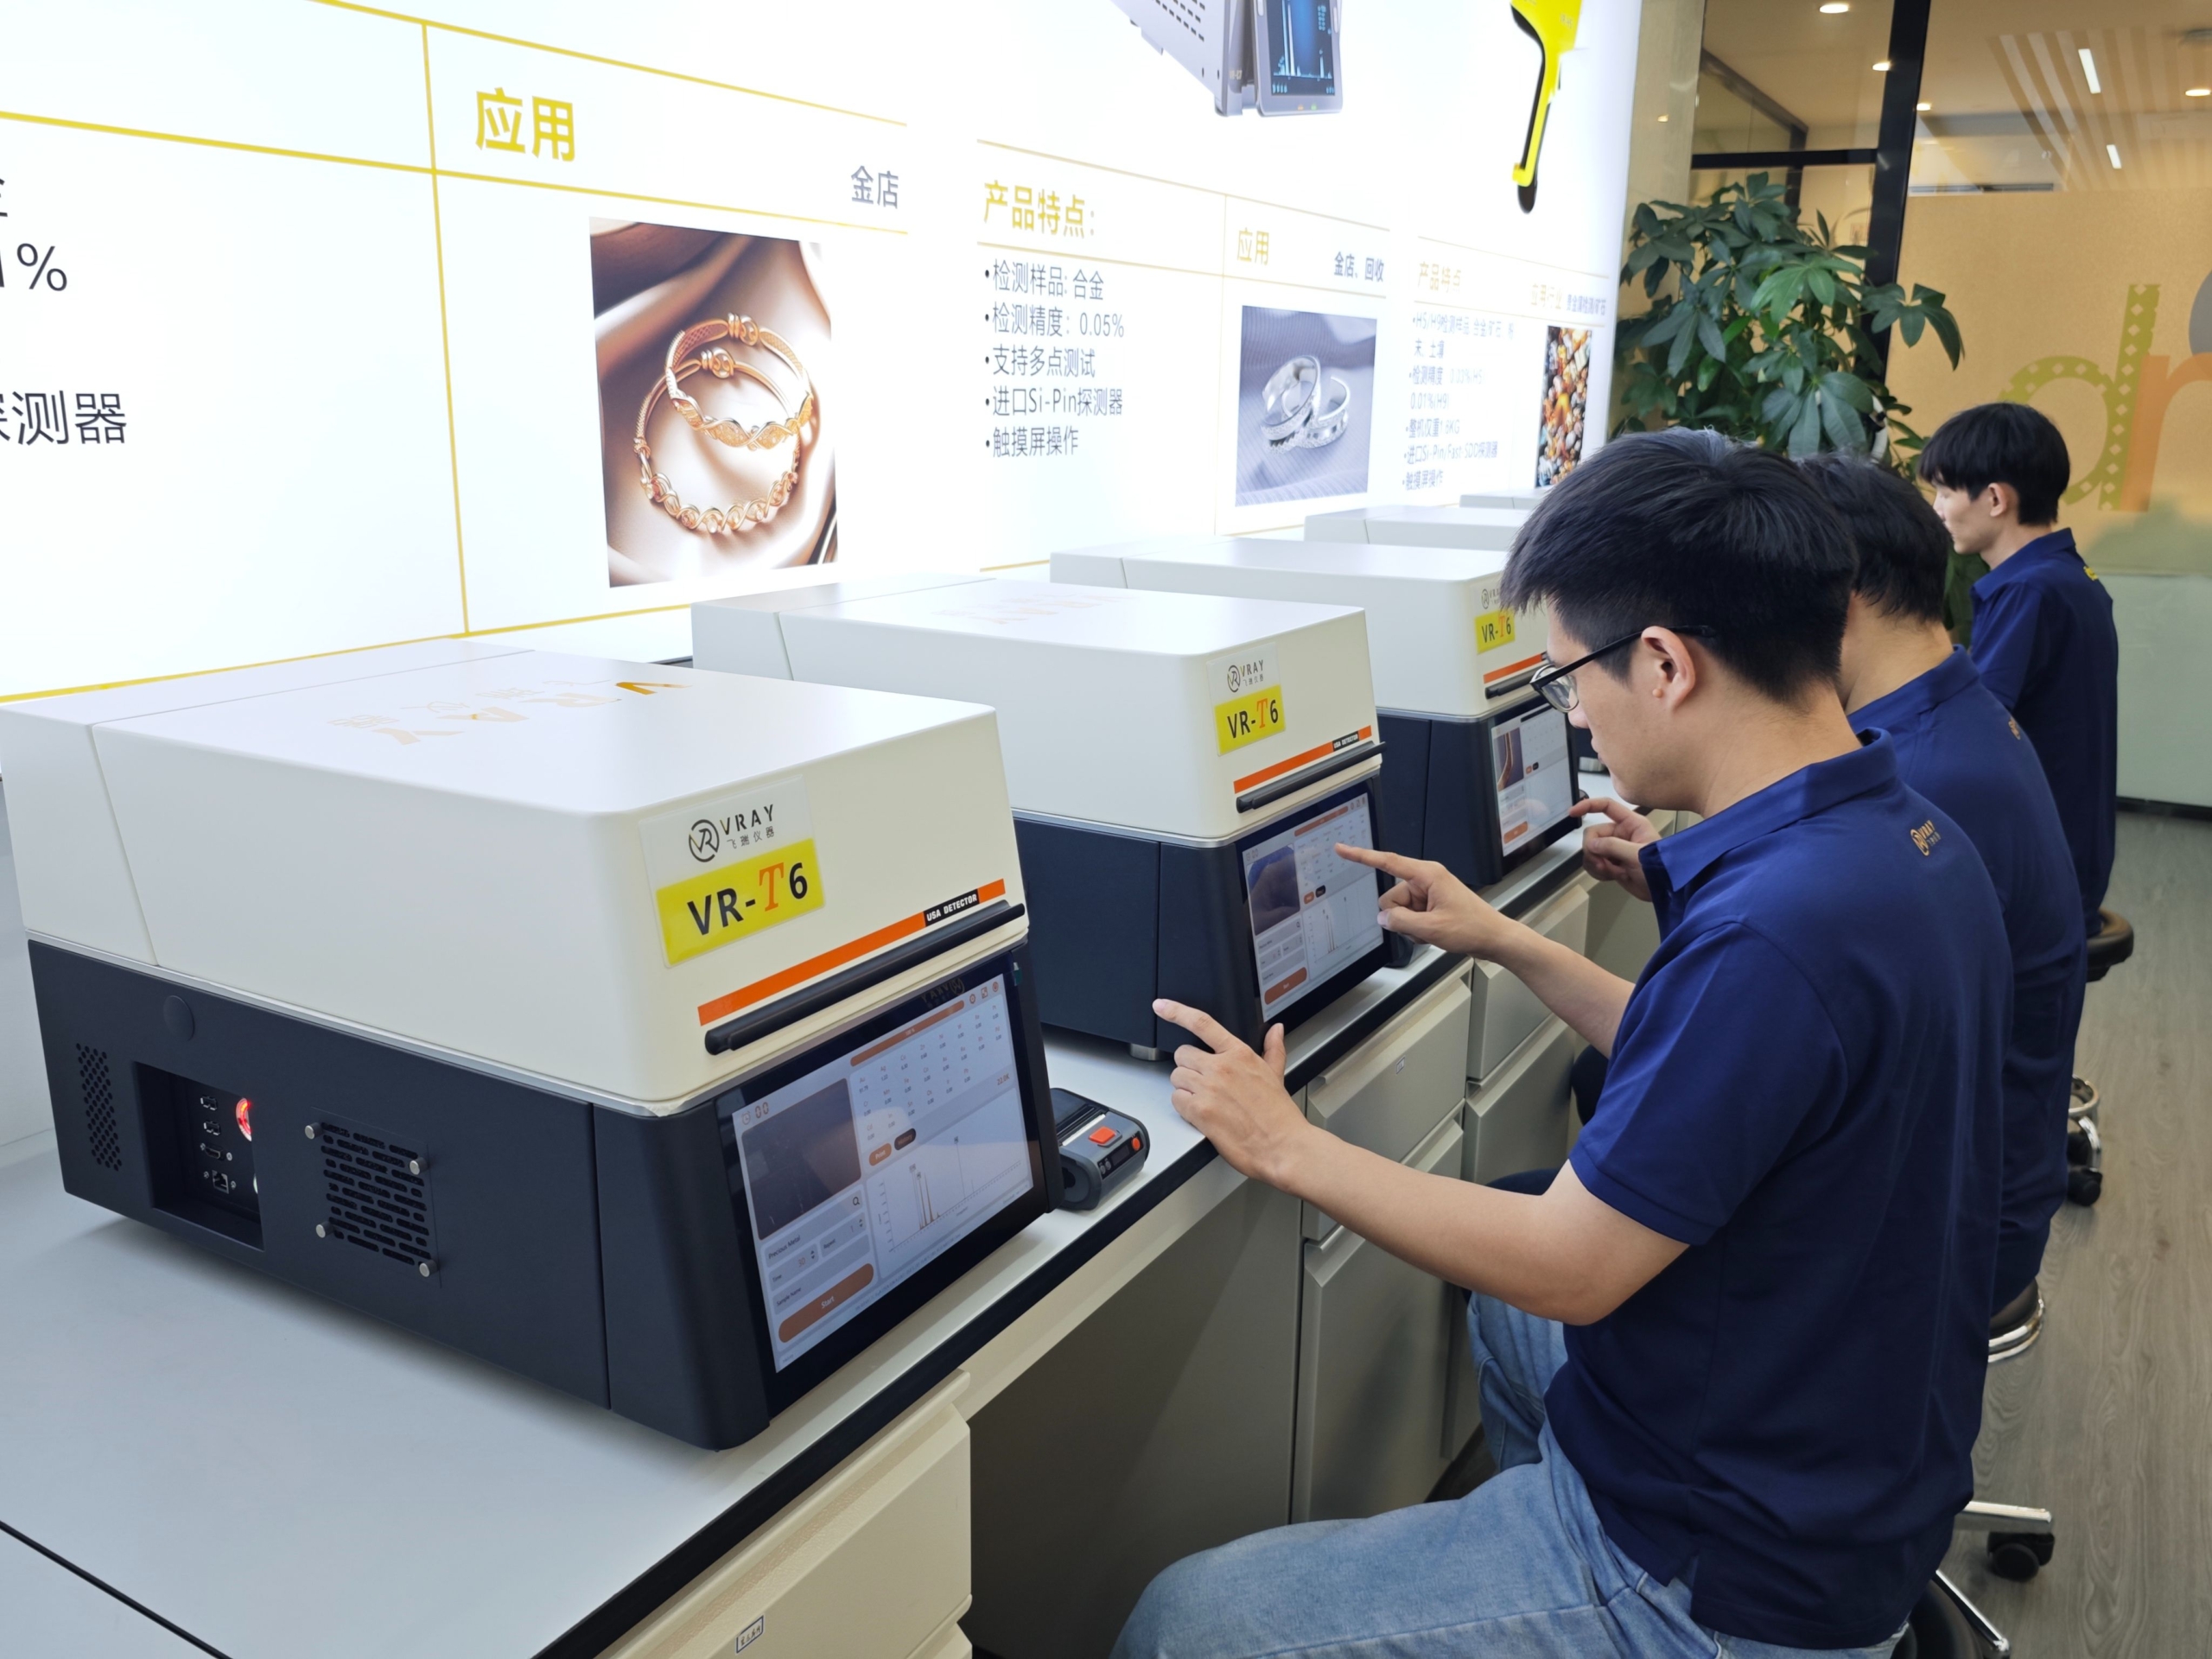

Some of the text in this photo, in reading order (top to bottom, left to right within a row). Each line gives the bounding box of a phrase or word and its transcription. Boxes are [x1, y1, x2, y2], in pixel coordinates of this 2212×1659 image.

[474, 86, 575, 162] 应用
[850, 165, 899, 210] 金店
[1237, 226, 1269, 265] 应用
[1333, 251, 1384, 283] 金店、回收
[993, 344, 1096, 378] 支持多点测试
[993, 386, 1124, 417] 进口Si-Pin探测器
[0, 390, 127, 446] 测器
[993, 426, 1079, 458] 触摸屏操作
[1481, 614, 1512, 644] VR-T6
[1240, 659, 1264, 677] VRAY
[1227, 697, 1279, 740] VR-T6
[720, 804, 774, 836] VRAY
[727, 826, 775, 849] 飞瑞仪器
[687, 854, 808, 936] VR-T6
[926, 893, 978, 922] USA DETECTOR
[996, 1072, 1009, 1086] 22.0K
[754, 1101, 770, 1119] 00
[768, 1234, 800, 1260] Precious Metal
[821, 1294, 834, 1309] Start
